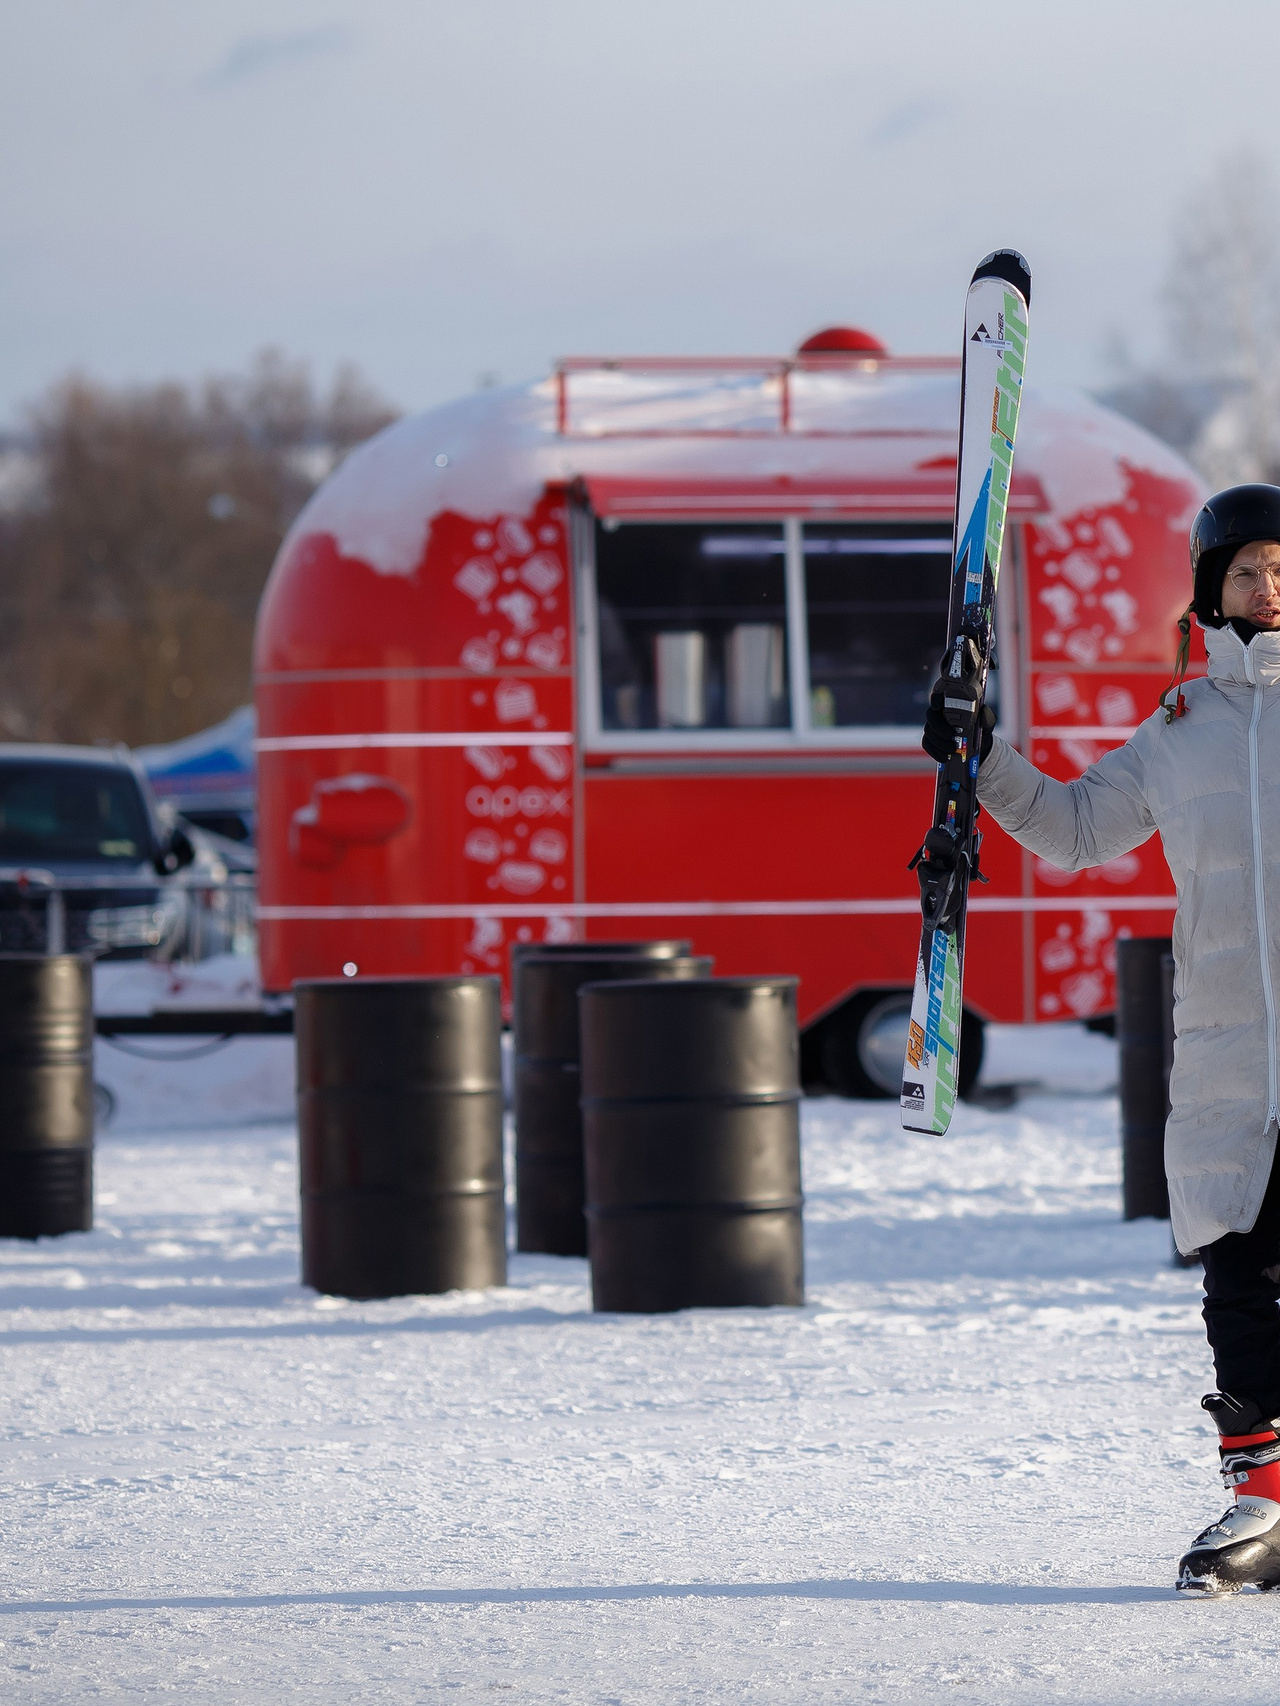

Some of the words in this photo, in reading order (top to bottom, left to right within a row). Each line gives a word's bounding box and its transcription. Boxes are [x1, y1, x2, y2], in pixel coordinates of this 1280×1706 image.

[465, 785, 573, 824] apex
[925, 929, 950, 1058] sportste
[906, 1018, 925, 1071] 160
